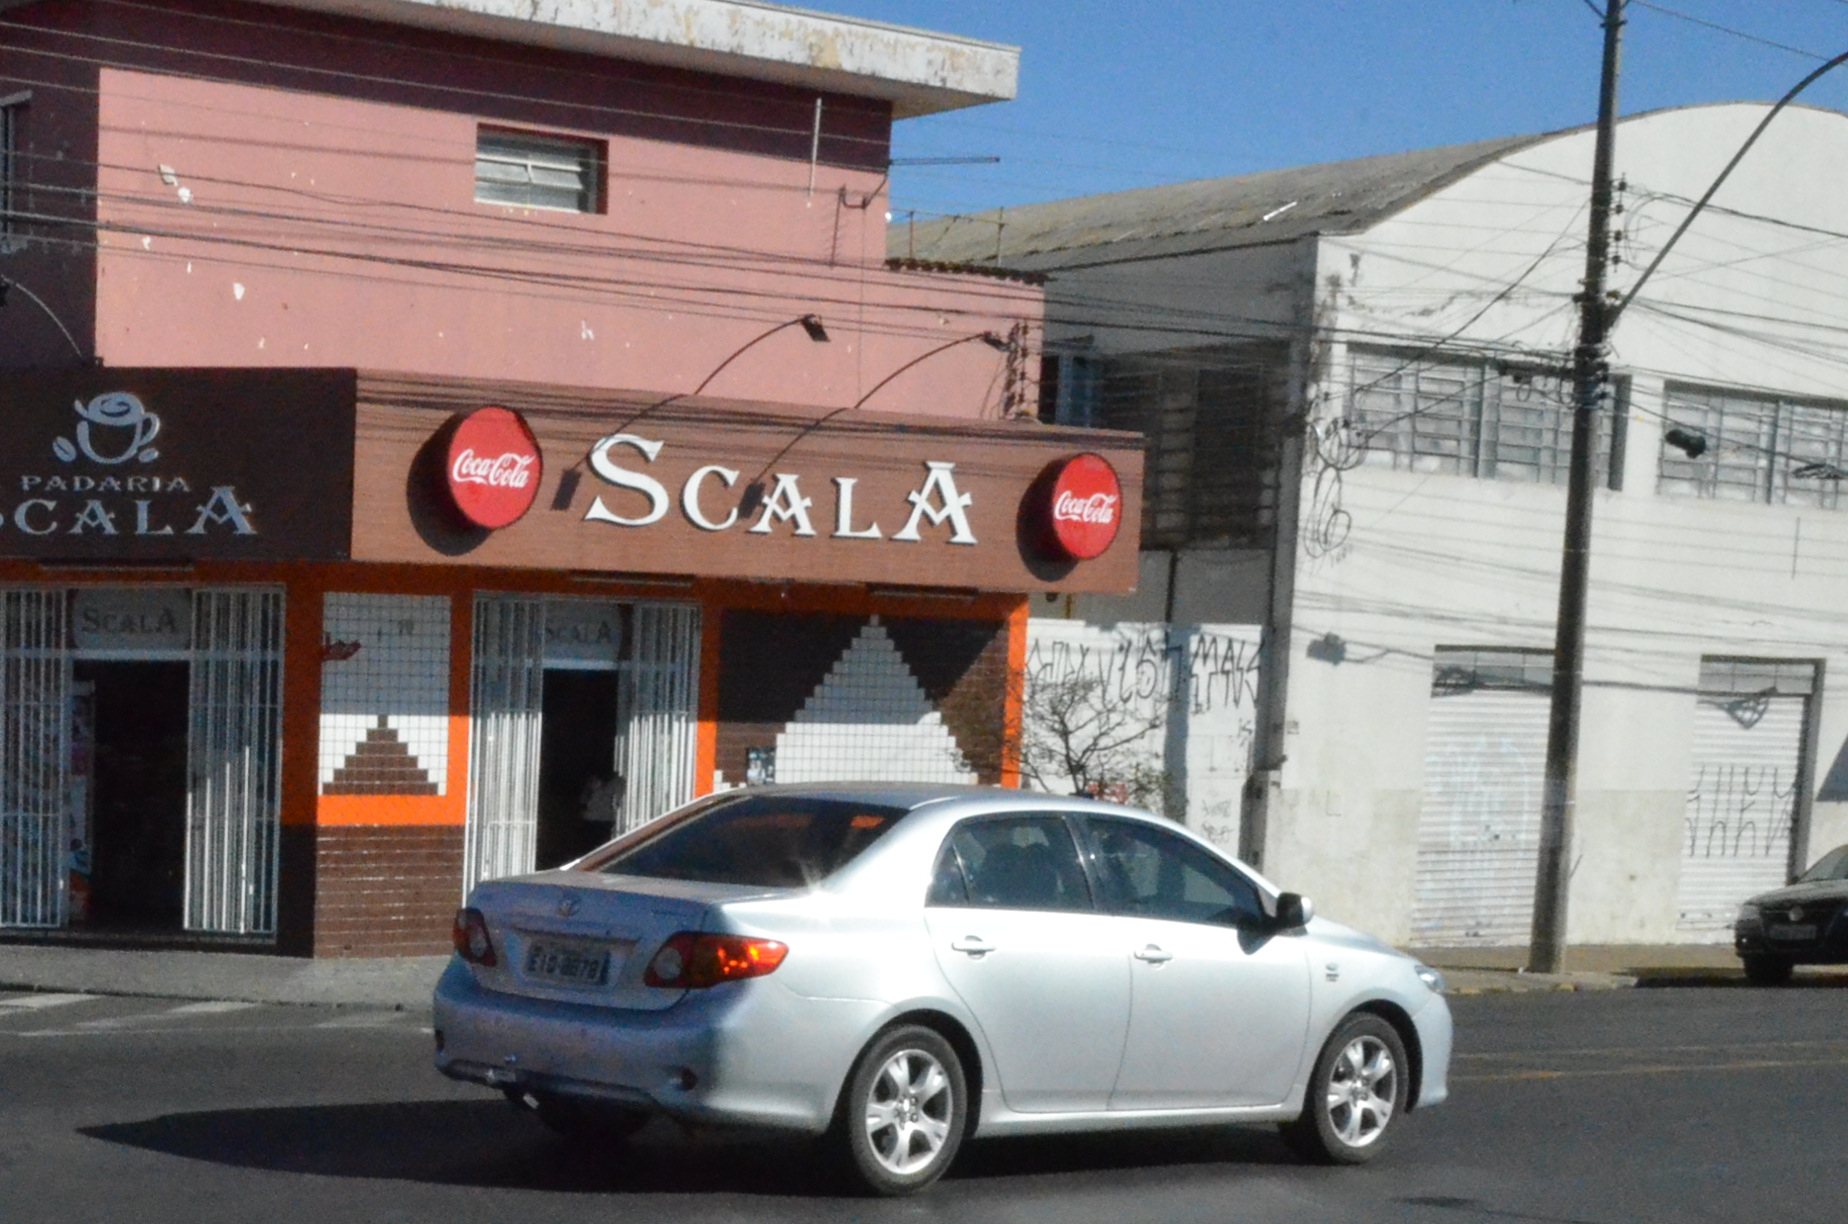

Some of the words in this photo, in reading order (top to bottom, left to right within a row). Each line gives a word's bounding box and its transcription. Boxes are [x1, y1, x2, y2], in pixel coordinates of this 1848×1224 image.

[21, 475, 191, 492] PADARIA
[453, 448, 536, 488] Coca-Cola
[584, 434, 978, 544] SCALA
[1054, 490, 1118, 524] Coca-Cola
[81, 607, 178, 634] SCALA
